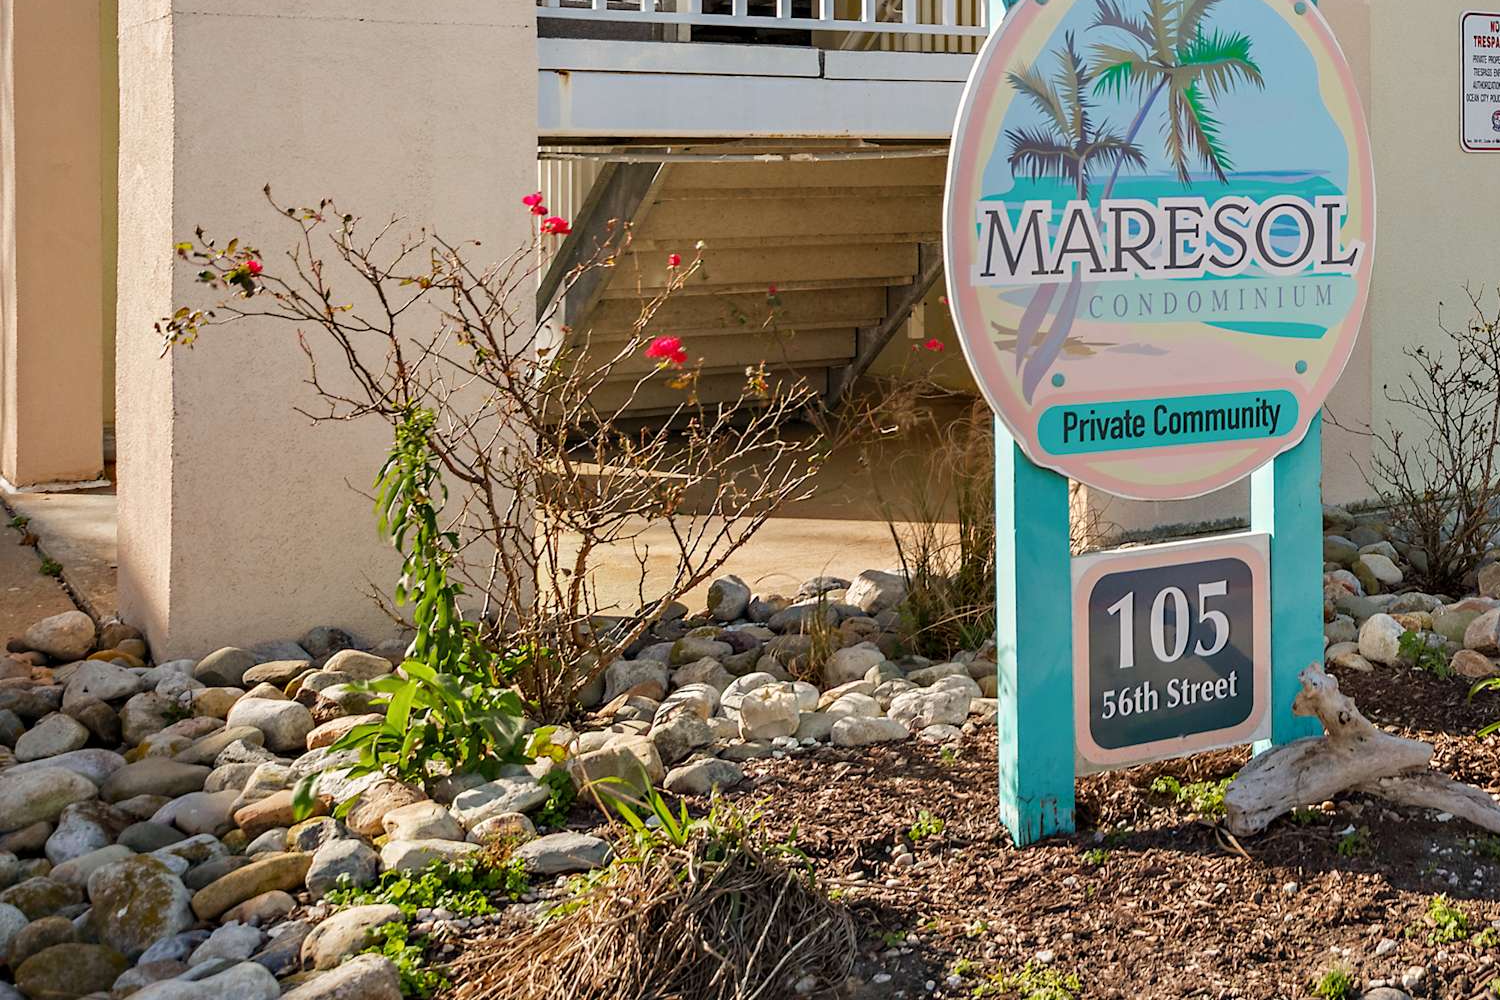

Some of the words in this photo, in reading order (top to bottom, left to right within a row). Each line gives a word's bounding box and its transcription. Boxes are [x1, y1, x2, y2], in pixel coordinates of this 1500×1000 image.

[1490, 21, 1500, 32] NO
[1472, 55, 1487, 64] PRIVATE
[1473, 68, 1492, 77] TRESPASS
[1472, 81, 1500, 90] AUTHORIZATION
[1466, 94, 1479, 102] OCEAN
[1480, 94, 1489, 102] CITY
[980, 203, 1359, 276] MARESOL
[1089, 284, 1334, 319] CONDOMINIUM
[1062, 409, 1146, 443] Private
[1153, 398, 1282, 437] Community
[1106, 579, 1230, 669] 105
[1101, 680, 1158, 720] 56th
[1167, 670, 1238, 709] Street
